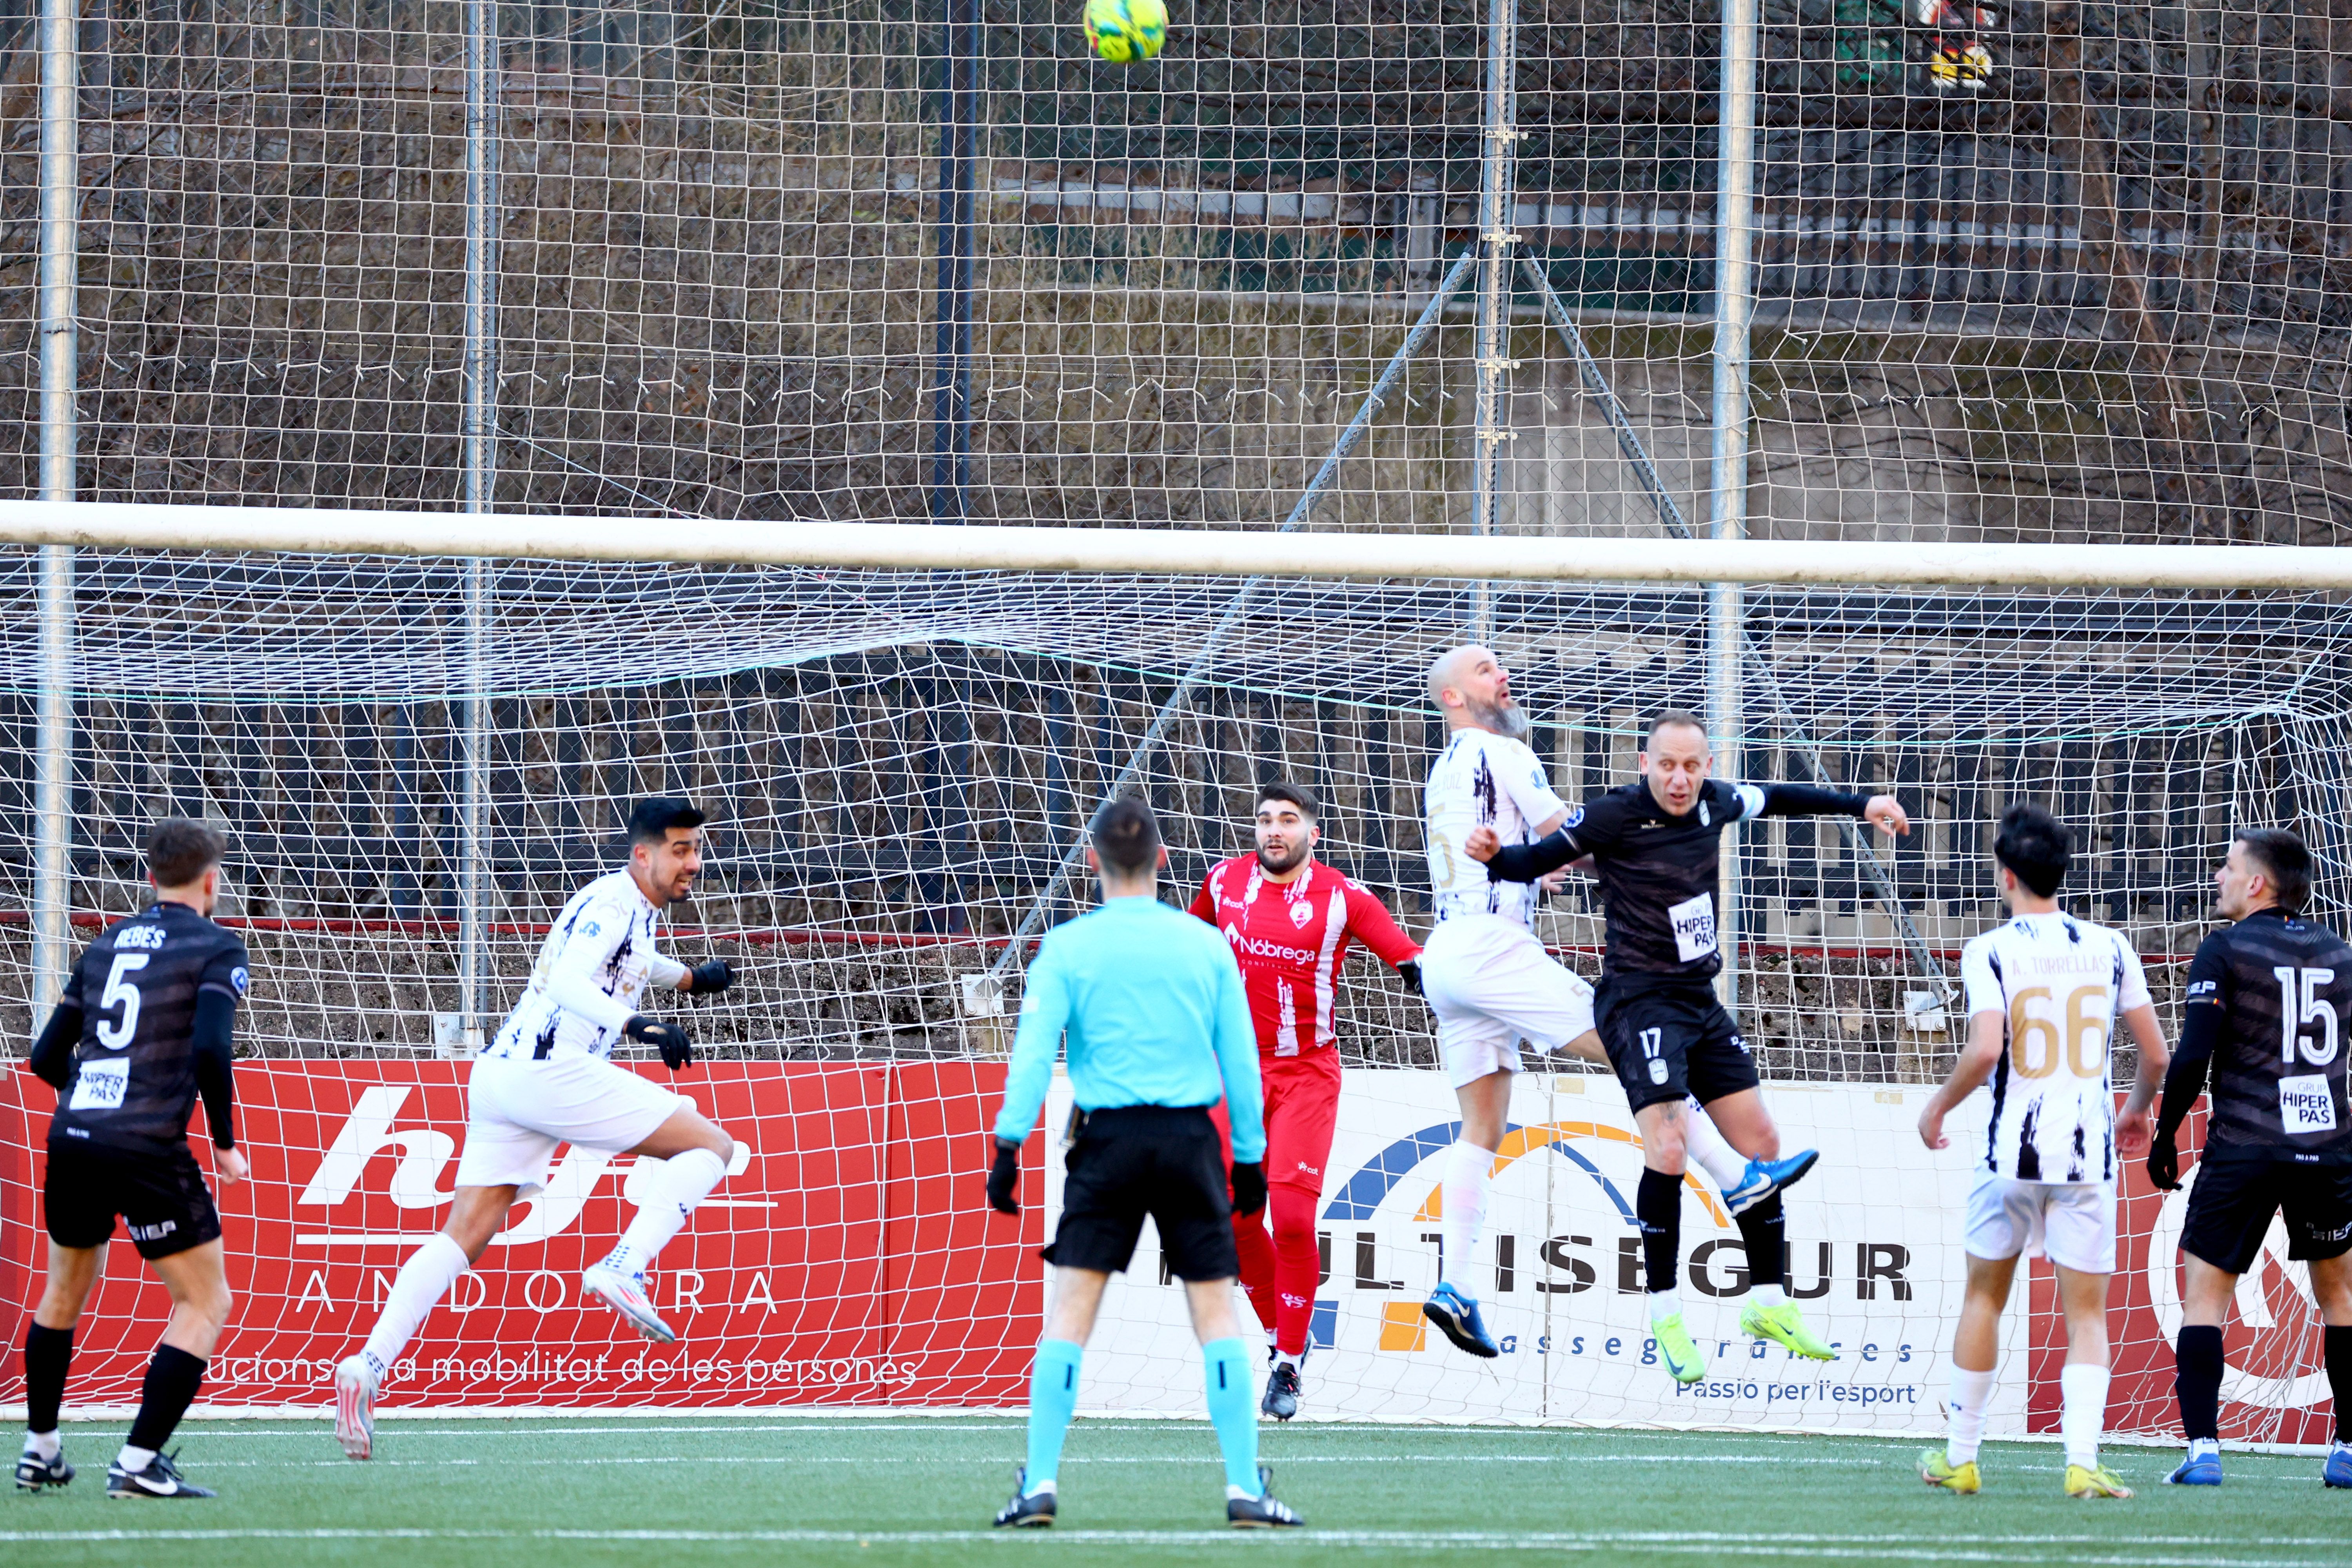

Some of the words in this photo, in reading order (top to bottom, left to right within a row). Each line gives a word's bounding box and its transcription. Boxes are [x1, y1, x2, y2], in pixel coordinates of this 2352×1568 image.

[113, 925, 166, 949] REBÉS
[1677, 916, 1712, 934] HIPER
[1695, 930, 1713, 948] PAS
[1240, 935, 1316, 965] Nóbrega
[2031, 955, 2108, 975] TORRELLAS
[96, 953, 150, 1050] 5
[2274, 966, 2338, 1067] 15
[1639, 1027, 1661, 1059] 17
[2010, 985, 2108, 1079] 66
[2283, 1091, 2328, 1109] HIPER
[2298, 1082, 2327, 1093] GRUP
[2299, 1109, 2330, 1124] PAS
[1159, 1231, 1913, 1301] LISEGUR
[295, 1270, 777, 1314] ANDORA
[432, 1350, 608, 1381] mobilitat
[621, 1350, 669, 1382] de
[683, 1350, 732, 1382] les
[746, 1359, 916, 1390] persones
[1676, 1378, 1759, 1399] Passió
[1768, 1383, 1810, 1405] per
[1819, 1380, 1916, 1407] l'esport
